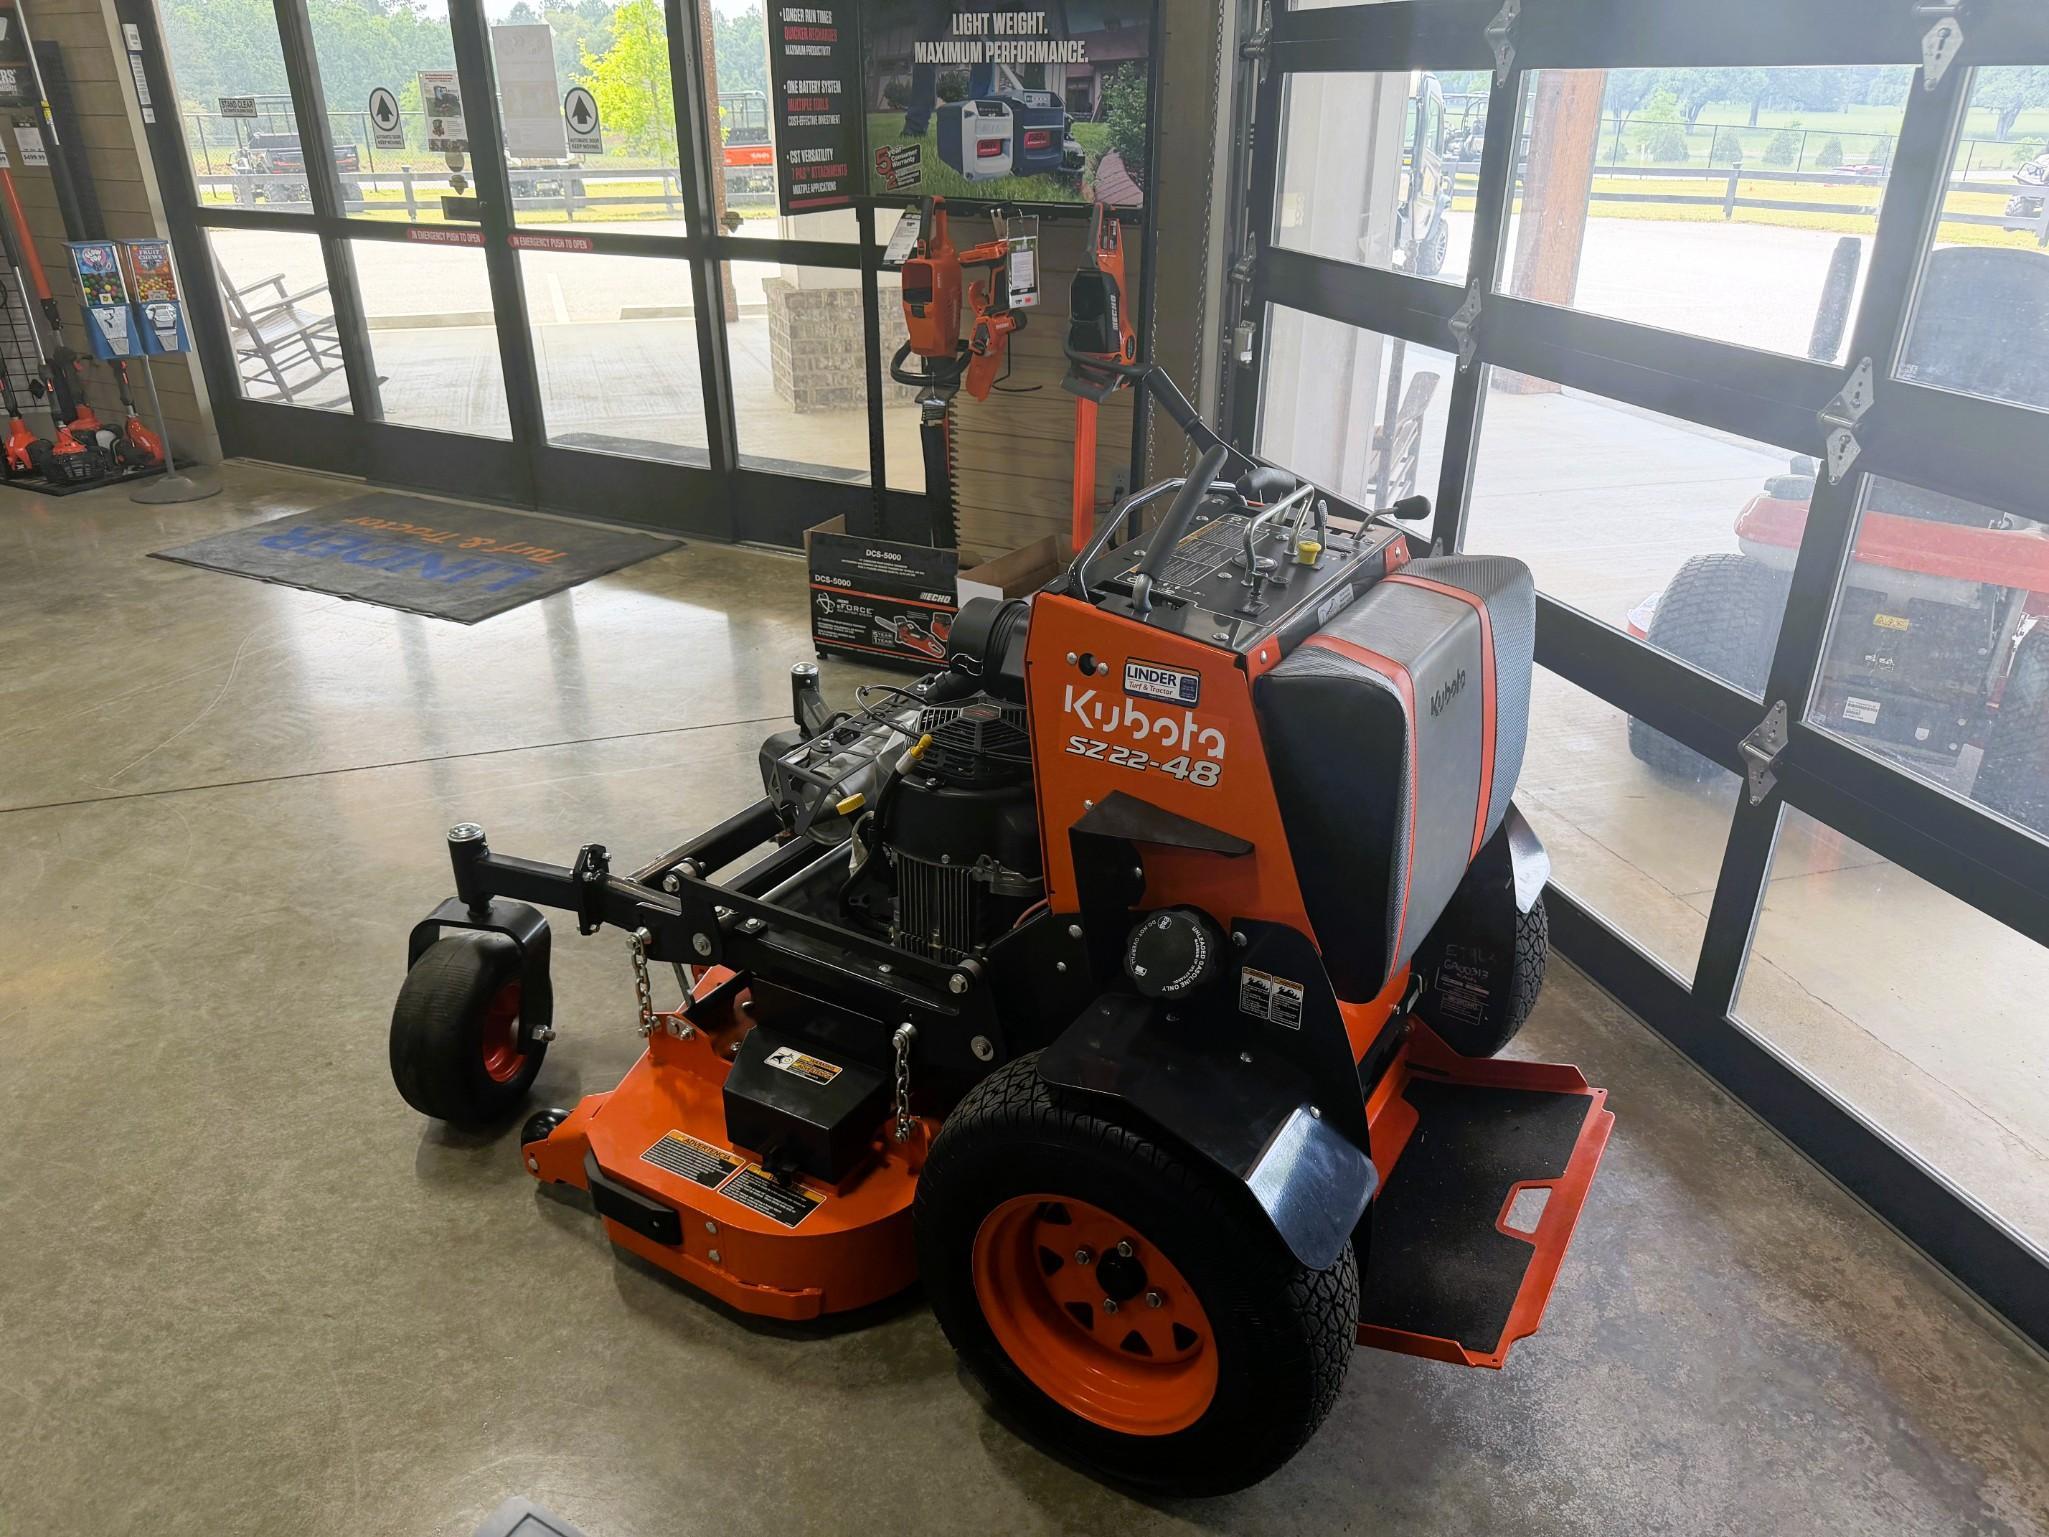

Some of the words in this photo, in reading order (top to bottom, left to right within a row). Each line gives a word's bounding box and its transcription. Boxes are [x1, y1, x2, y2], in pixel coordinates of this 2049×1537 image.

[817, 10, 832, 24] TIMES
[952, 13, 989, 35] LIGHT
[993, 12, 1048, 35] WEIGHT.
[914, 42, 982, 63] MAXIMUM
[986, 41, 1089, 63] PERFORMANCE.
[787, 80, 798, 93] ONE
[799, 80, 820, 93] BATTERY
[821, 80, 841, 93] SYSTEM
[789, 150, 801, 164] CST
[801, 148, 834, 163] VERSATILITY
[412, 230, 418, 239] IN
[418, 230, 446, 241] EMERGENCY
[446, 232, 460, 241] PUSH
[460, 233, 467, 242] TO
[467, 233, 481, 243] OPEN
[513, 236, 519, 246] IN
[520, 237, 550, 247] EMERGENCY
[550, 238, 565, 248] PUSH
[565, 239, 572, 248] TO
[573, 239, 587, 249] OPEN
[343, 516, 460, 544] Tractor
[457, 536, 497, 549] &
[260, 527, 544, 592] LINDER
[866, 549, 902, 561] DCS-5000
[814, 574, 851, 587] DCS-5000
[921, 592, 952, 603] ECHO
[1127, 666, 1177, 687] LINDER
[1149, 685, 1174, 696] Tractor
[1430, 667, 1466, 717] Kubota
[1064, 684, 1225, 760] Kubota
[1139, 925, 1148, 937] NOT
[1191, 926, 1206, 960] UNLEADED
[1180, 960, 1205, 988] GASOLINE
[1161, 983, 1180, 992] ONLY
[684, 1137, 731, 1161] ADVERTENCIA
